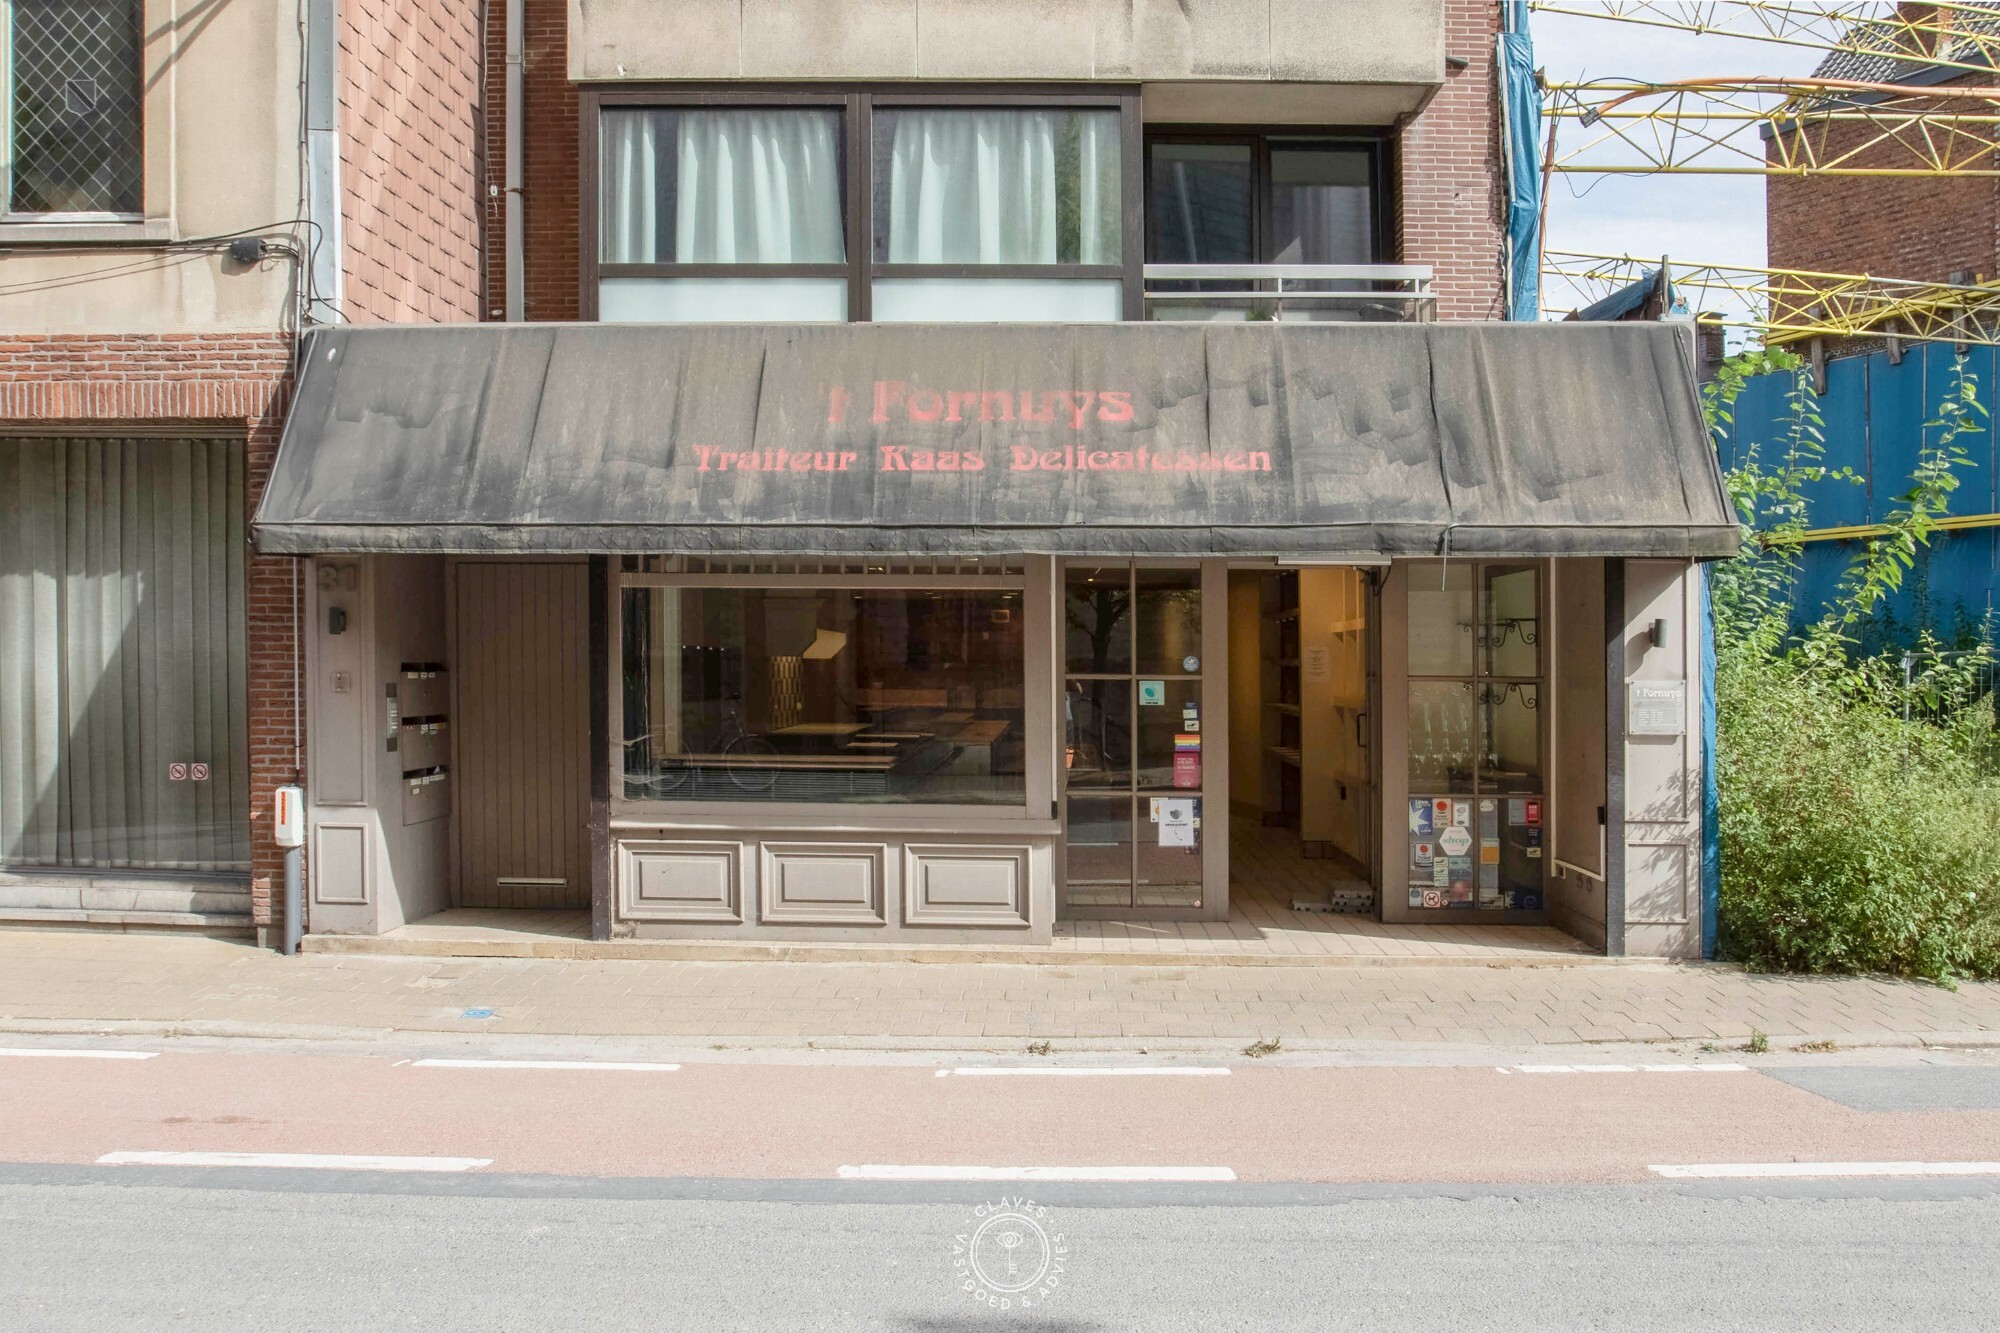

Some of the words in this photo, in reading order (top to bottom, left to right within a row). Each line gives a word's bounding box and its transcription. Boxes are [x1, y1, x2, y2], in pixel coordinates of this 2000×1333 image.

[869, 380, 1134, 430] Fornuys
[692, 444, 858, 472] Traiteur
[879, 445, 985, 471] Kaas
[1009, 444, 1272, 472] Delicatessen
[1643, 688, 1682, 699] Fornuys
